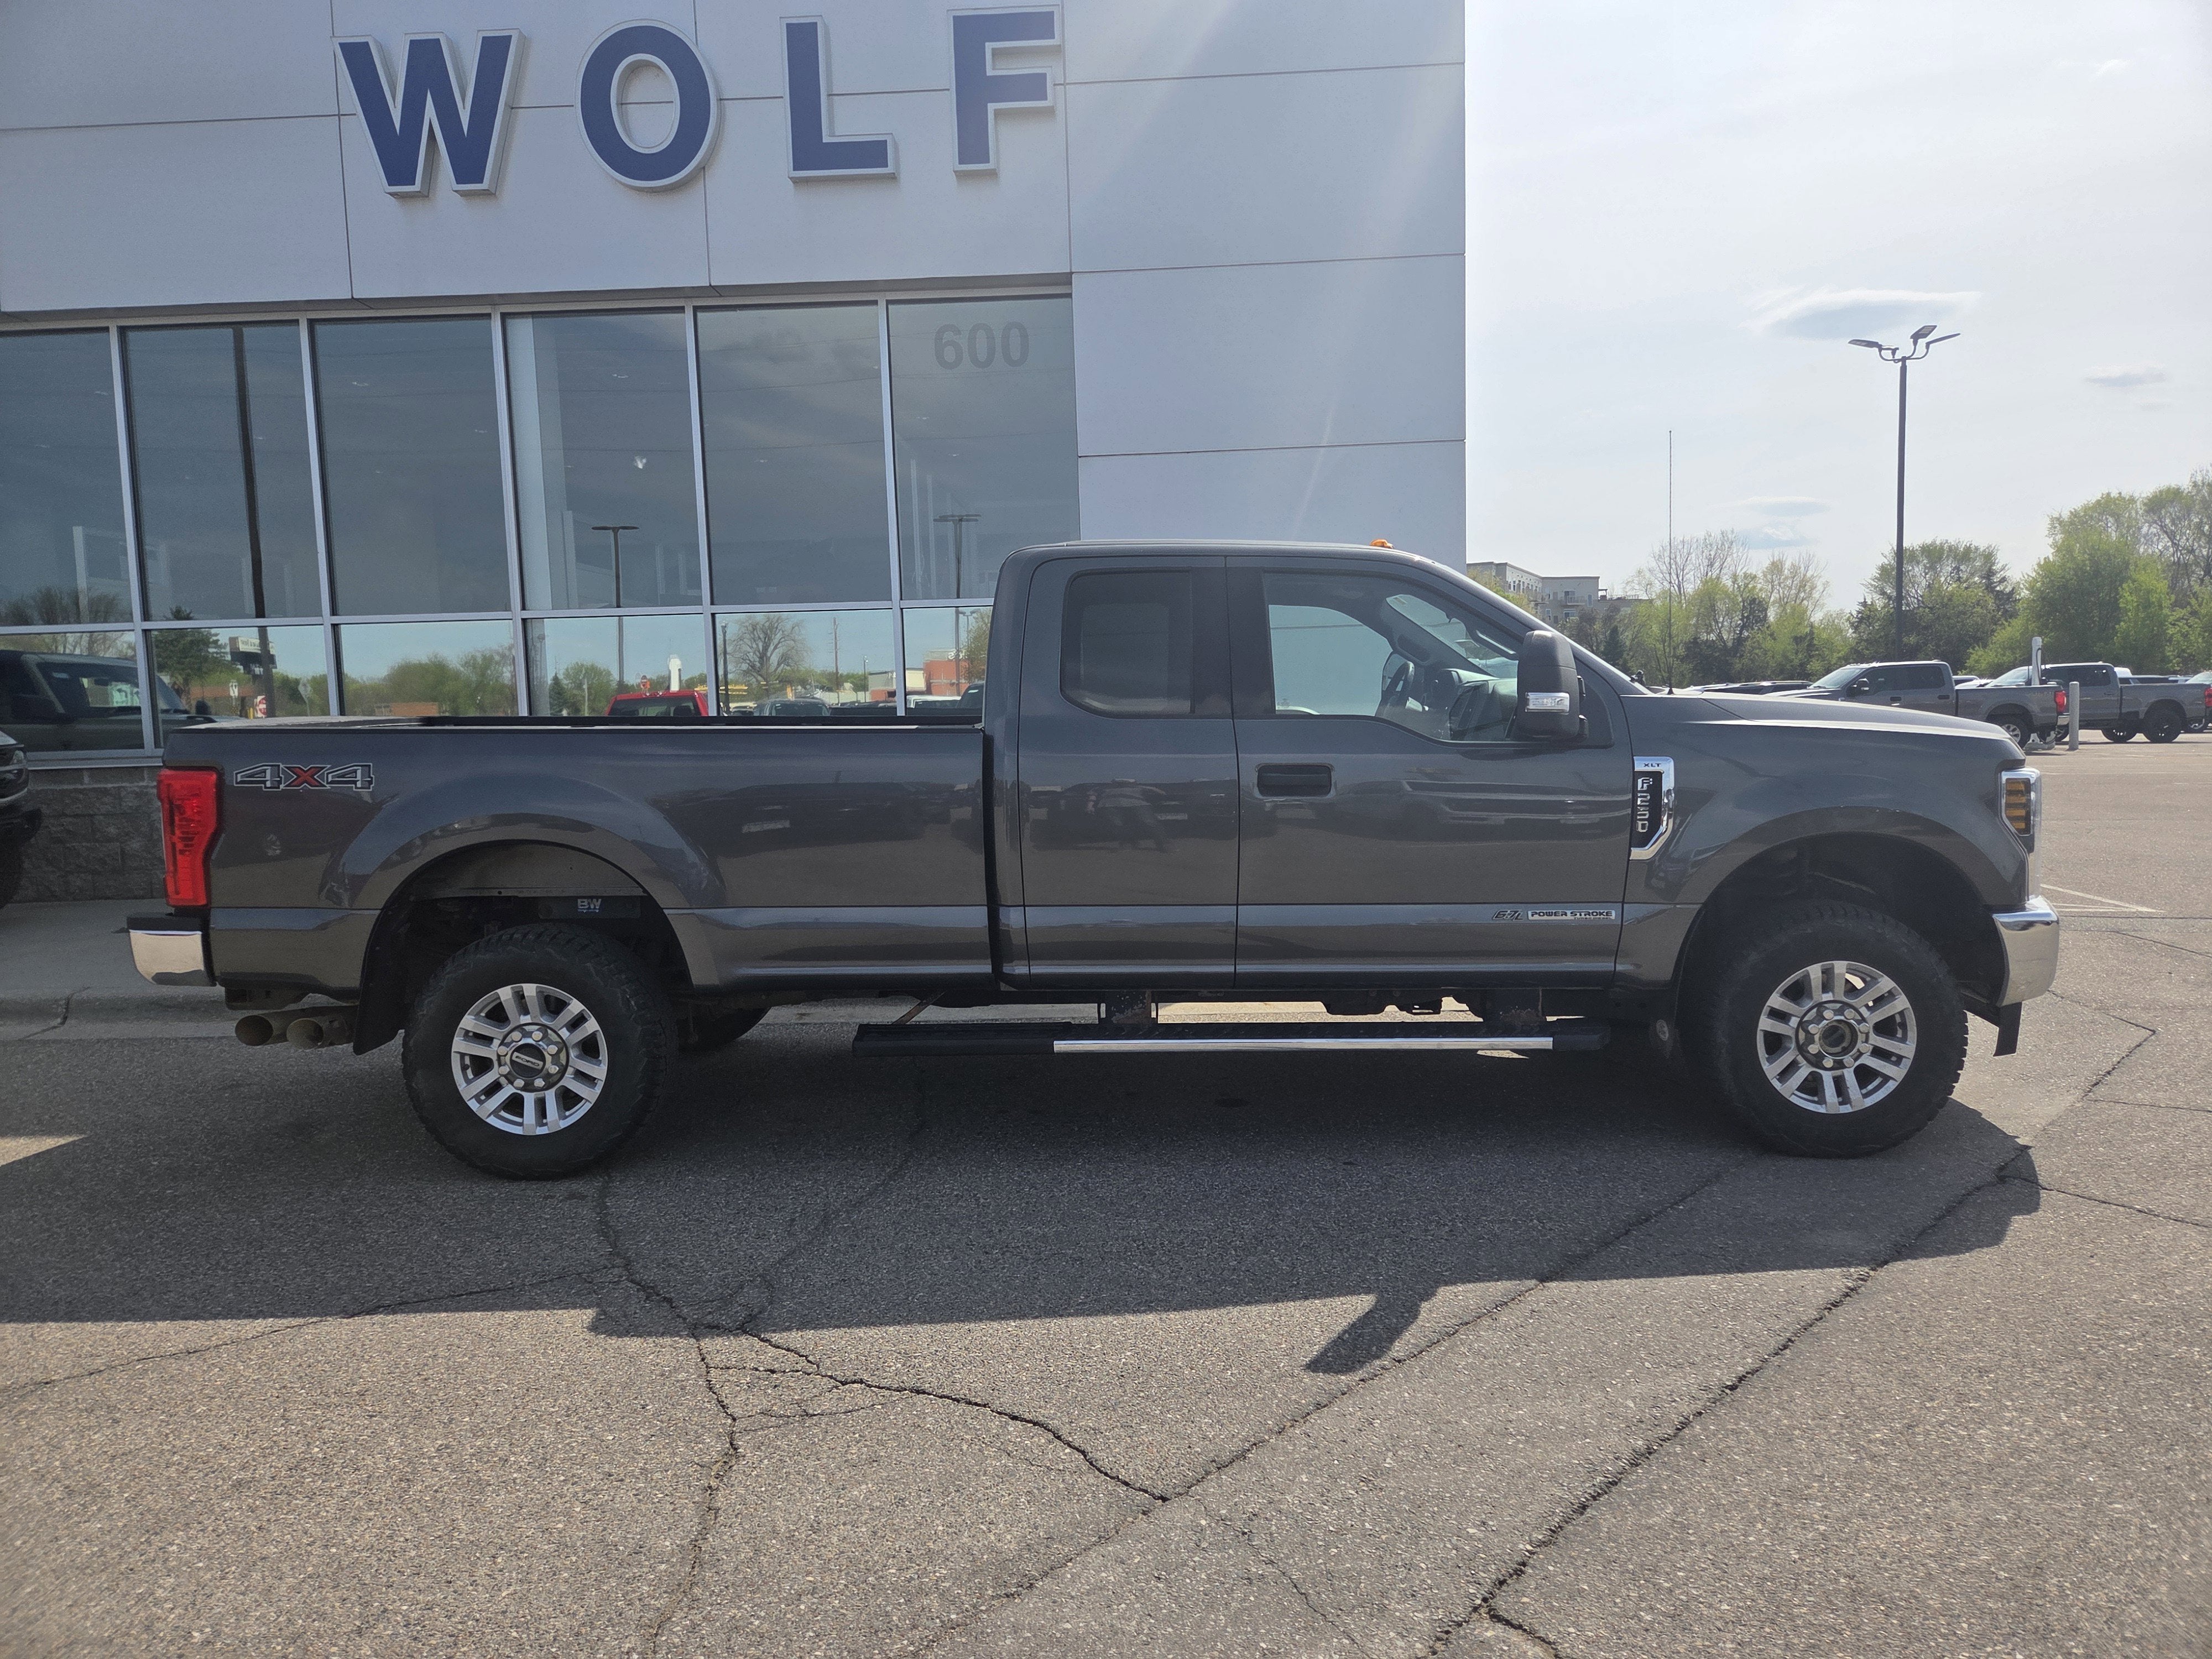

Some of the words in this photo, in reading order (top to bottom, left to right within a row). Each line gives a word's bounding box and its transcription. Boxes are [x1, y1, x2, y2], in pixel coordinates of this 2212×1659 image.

[334, 6, 1061, 196] WOLF
[935, 321, 1029, 370] 600
[515, 1056, 540, 1067] FORD
